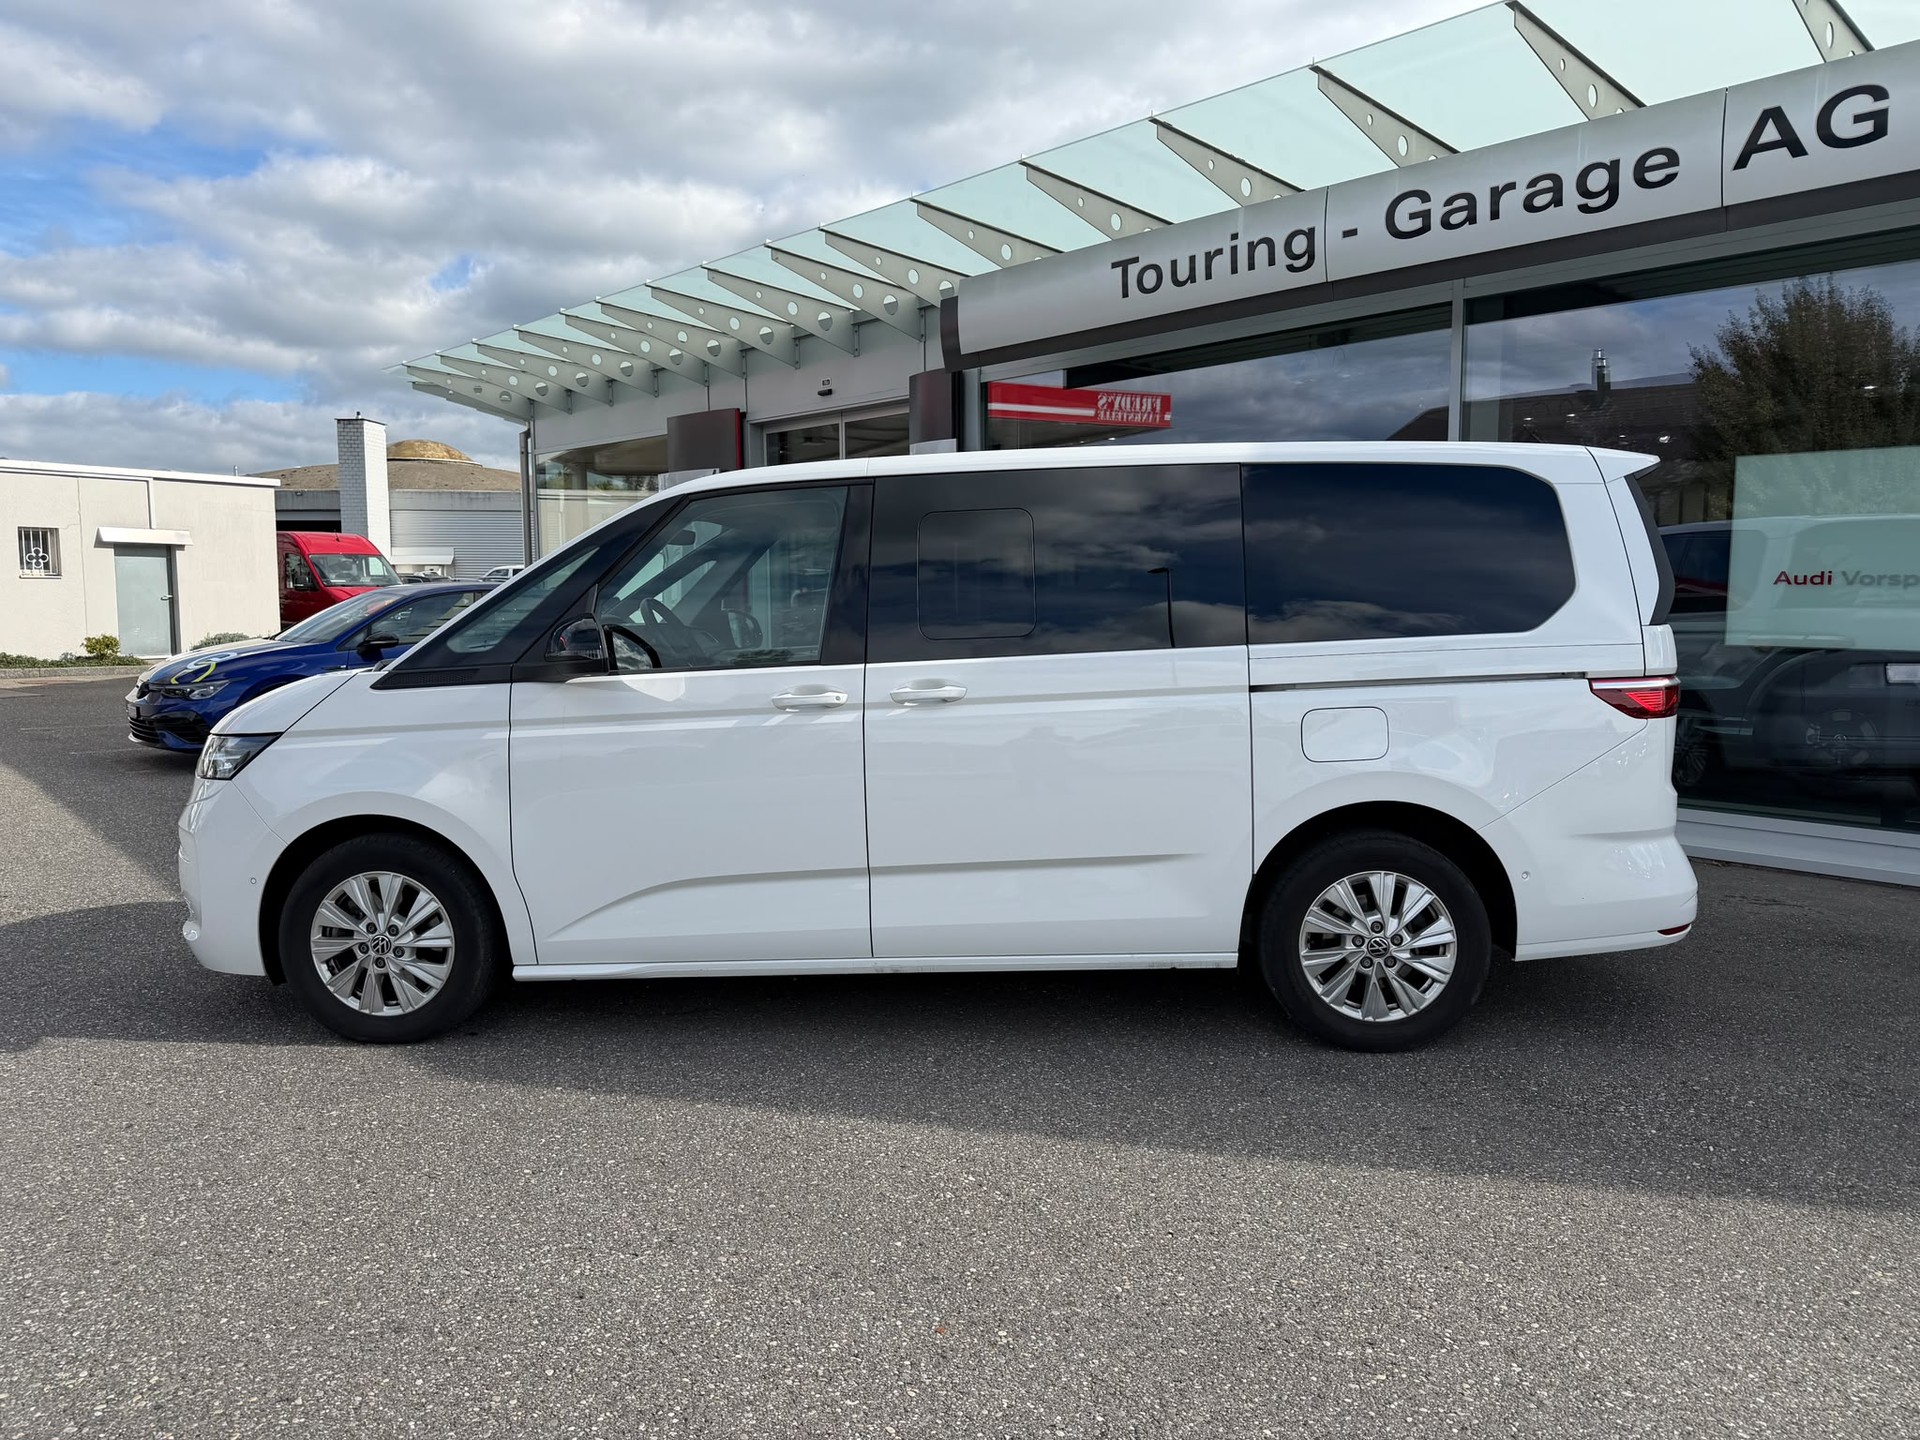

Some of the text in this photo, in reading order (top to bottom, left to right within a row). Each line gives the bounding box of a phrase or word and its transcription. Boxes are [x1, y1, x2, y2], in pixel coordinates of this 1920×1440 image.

[1111, 225, 1316, 299] Touring
[1385, 145, 1680, 240] Garage
[1732, 83, 1891, 172] AG
[1773, 570, 1833, 586] Audi
